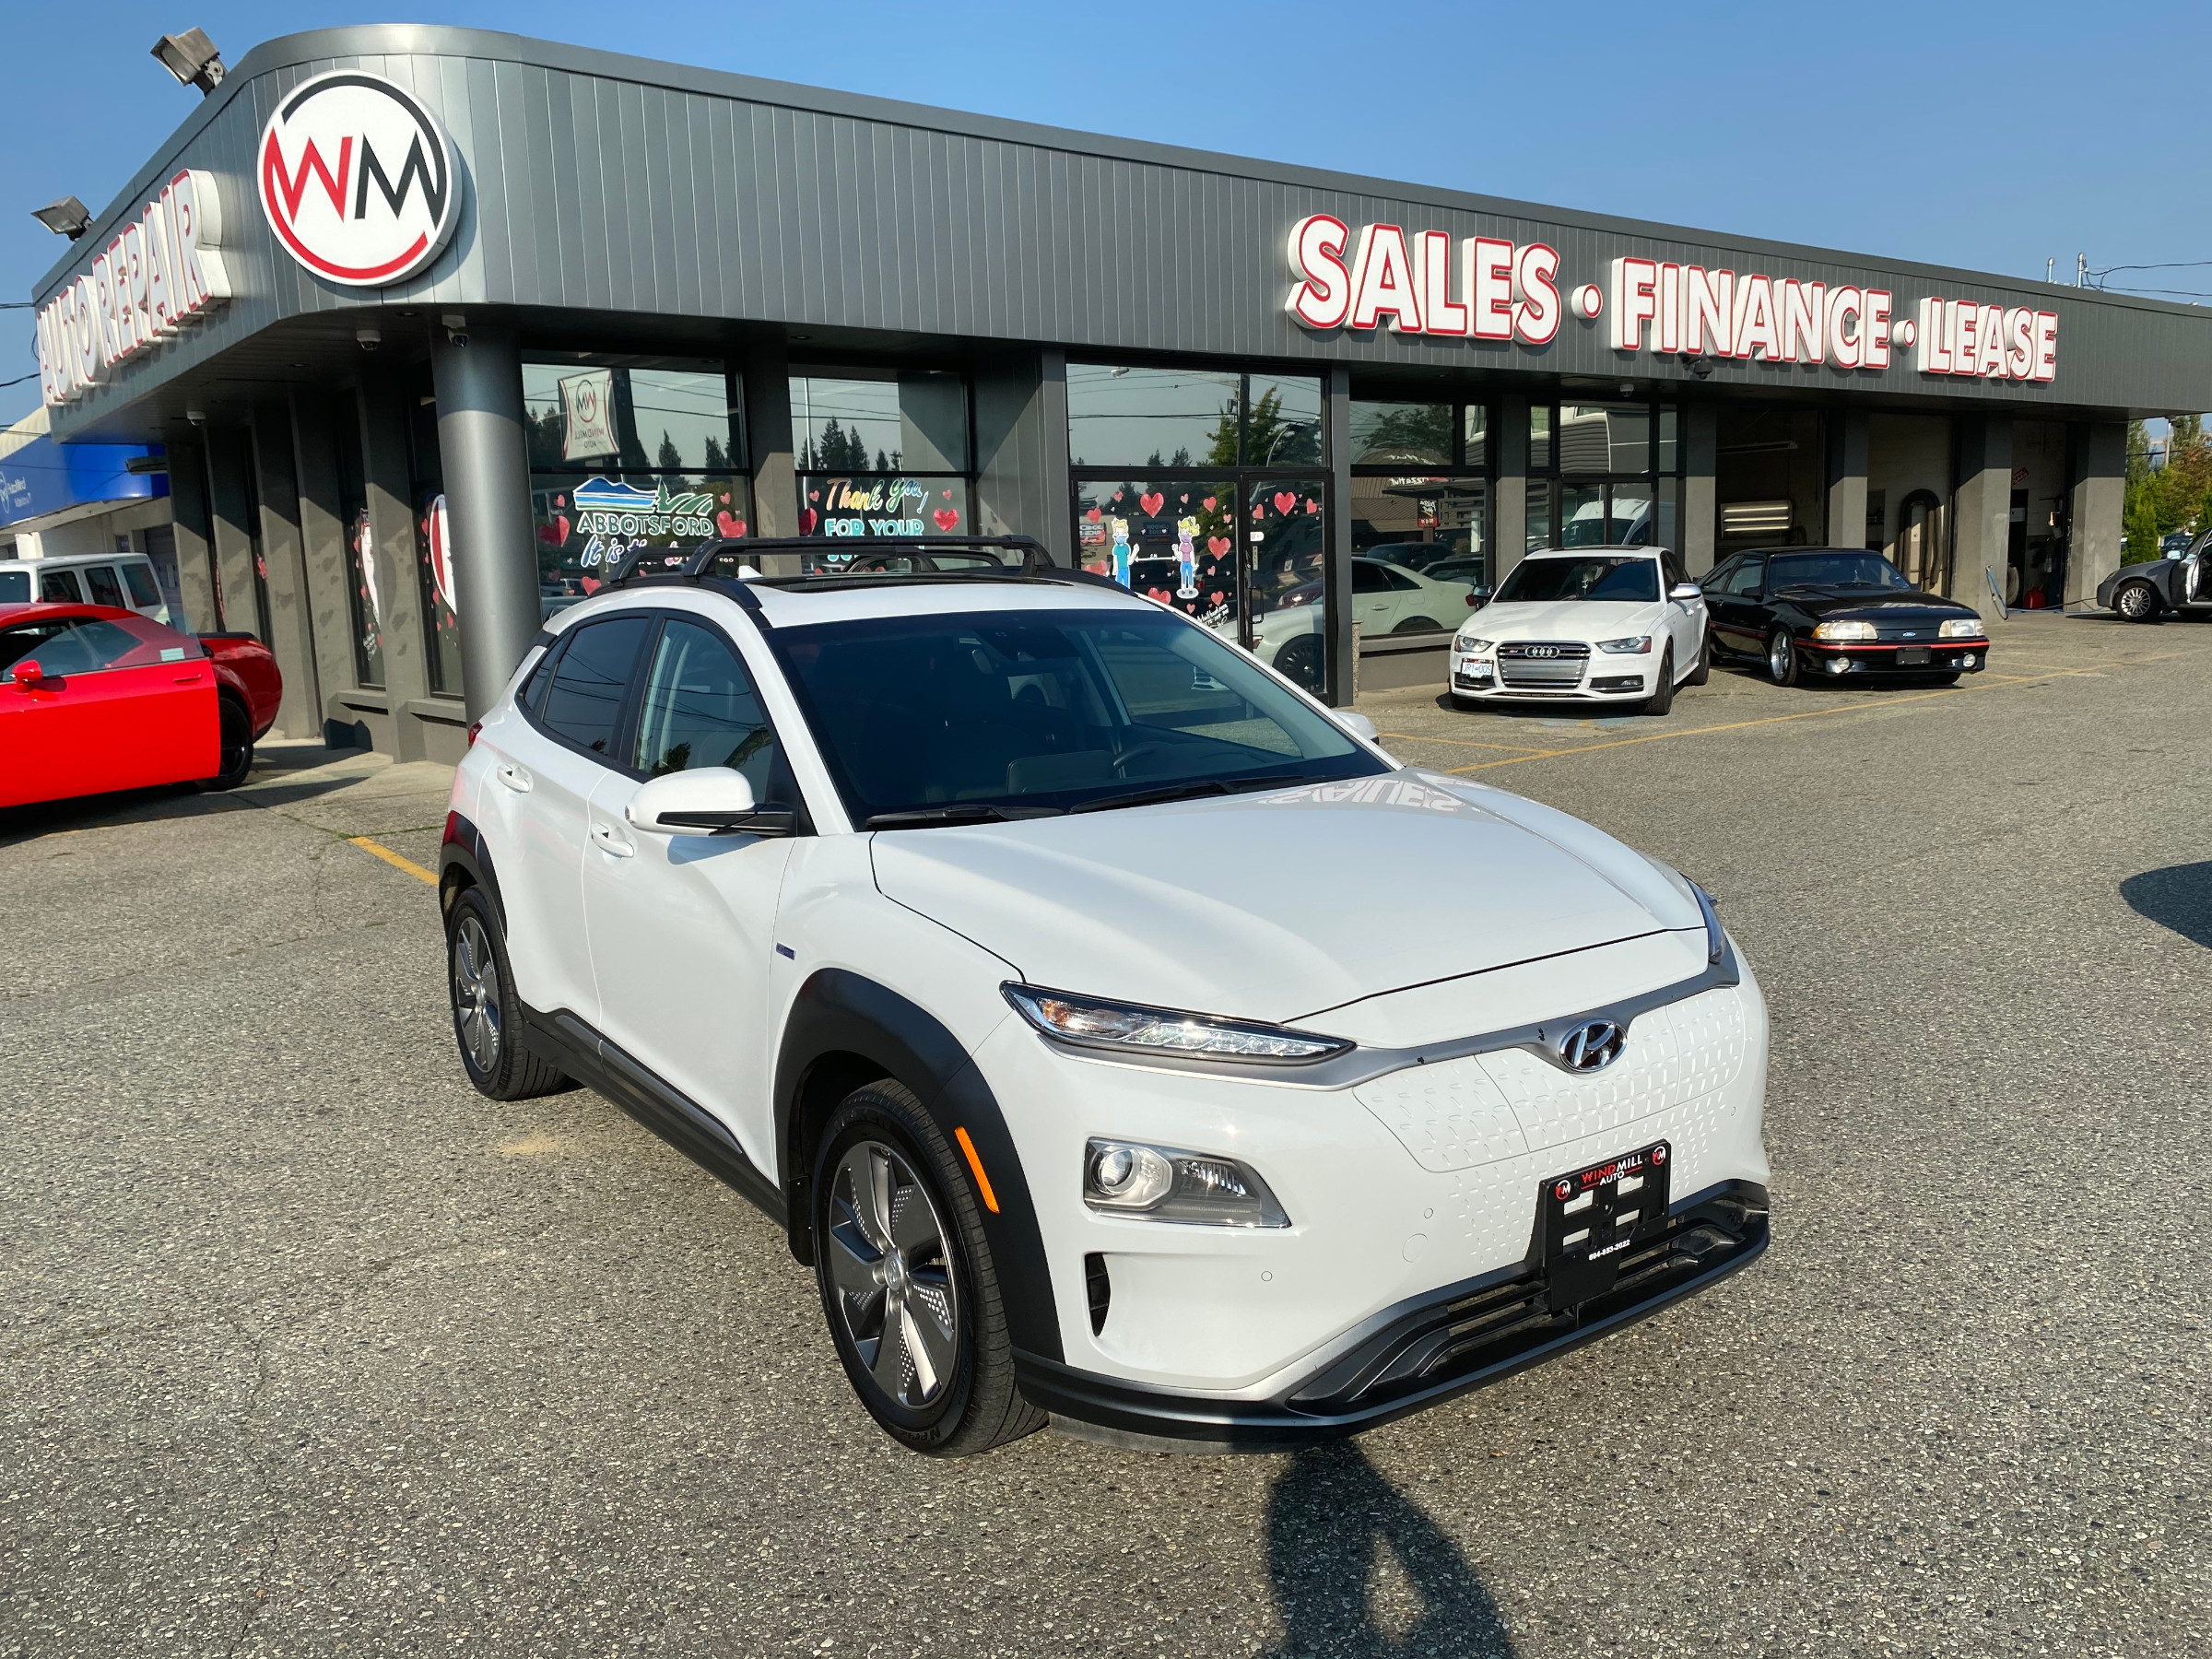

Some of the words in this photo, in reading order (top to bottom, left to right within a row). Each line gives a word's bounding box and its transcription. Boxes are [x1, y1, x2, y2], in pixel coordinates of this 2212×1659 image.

[37, 274, 108, 407] AUTO
[91, 168, 231, 369] REPAIR
[1285, 213, 1562, 346] SALES
[1611, 256, 1892, 370] FINANCE
[1917, 296, 2058, 382] LEASE
[826, 477, 885, 511] Thank
[576, 512, 714, 536] ABBOTSFORD
[825, 518, 865, 536] FOR
[868, 518, 924, 536] YOUR
[1582, 1154, 1642, 1183] WINDMILL
[1599, 1171, 1625, 1186] AUTO
